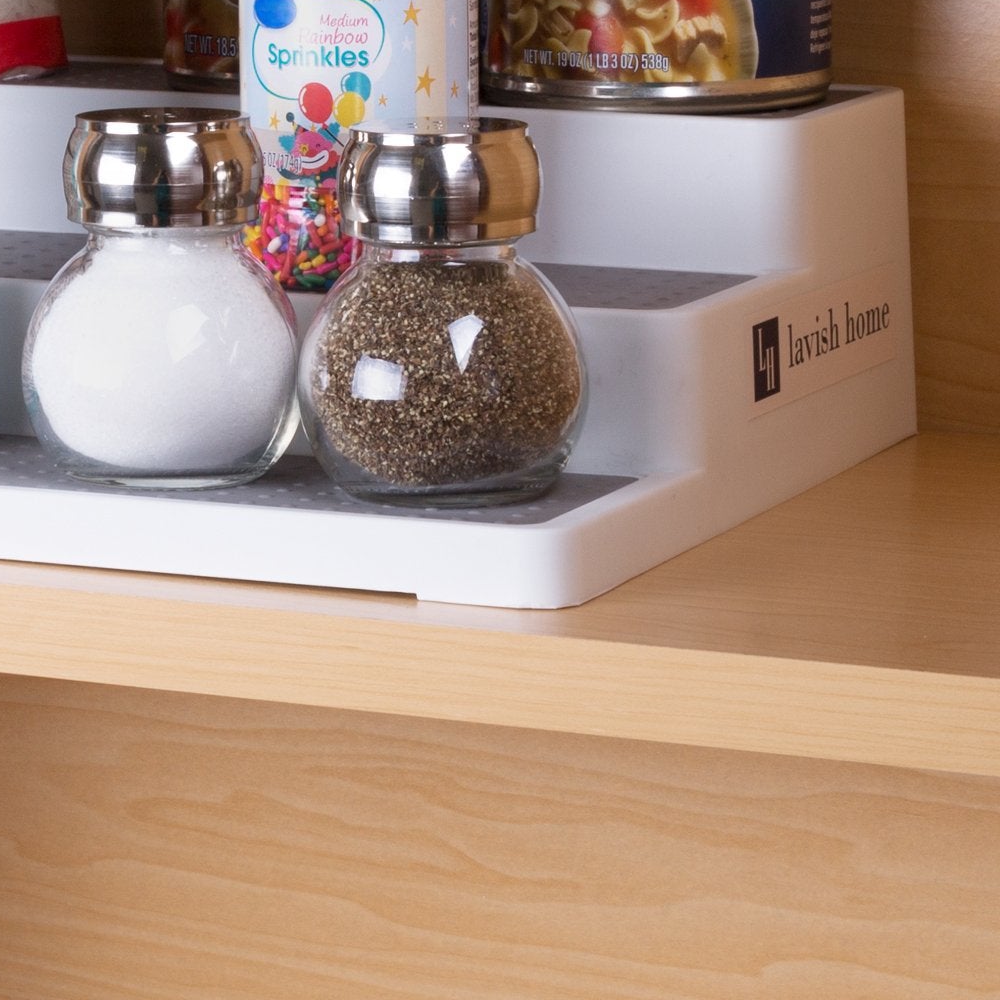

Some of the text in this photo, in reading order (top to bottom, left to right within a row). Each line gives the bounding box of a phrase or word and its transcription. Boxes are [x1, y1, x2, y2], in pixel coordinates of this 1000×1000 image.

[319, 13, 368, 27] Medium
[184, 32, 236, 57] NET WT. 18.5
[299, 27, 369, 45] Rainbow
[268, 43, 369, 70] Sprinkles
[523, 48, 538, 64] NET
[539, 50, 554, 66] WT.
[557, 51, 567, 66] 19
[569, 51, 581, 67] OZ
[596, 53, 609, 68] LB
[611, 53, 618, 69] 3
[620, 53, 639, 72] OZ)
[641, 53, 669, 72] 538g
[787, 301, 890, 368] lavish home
